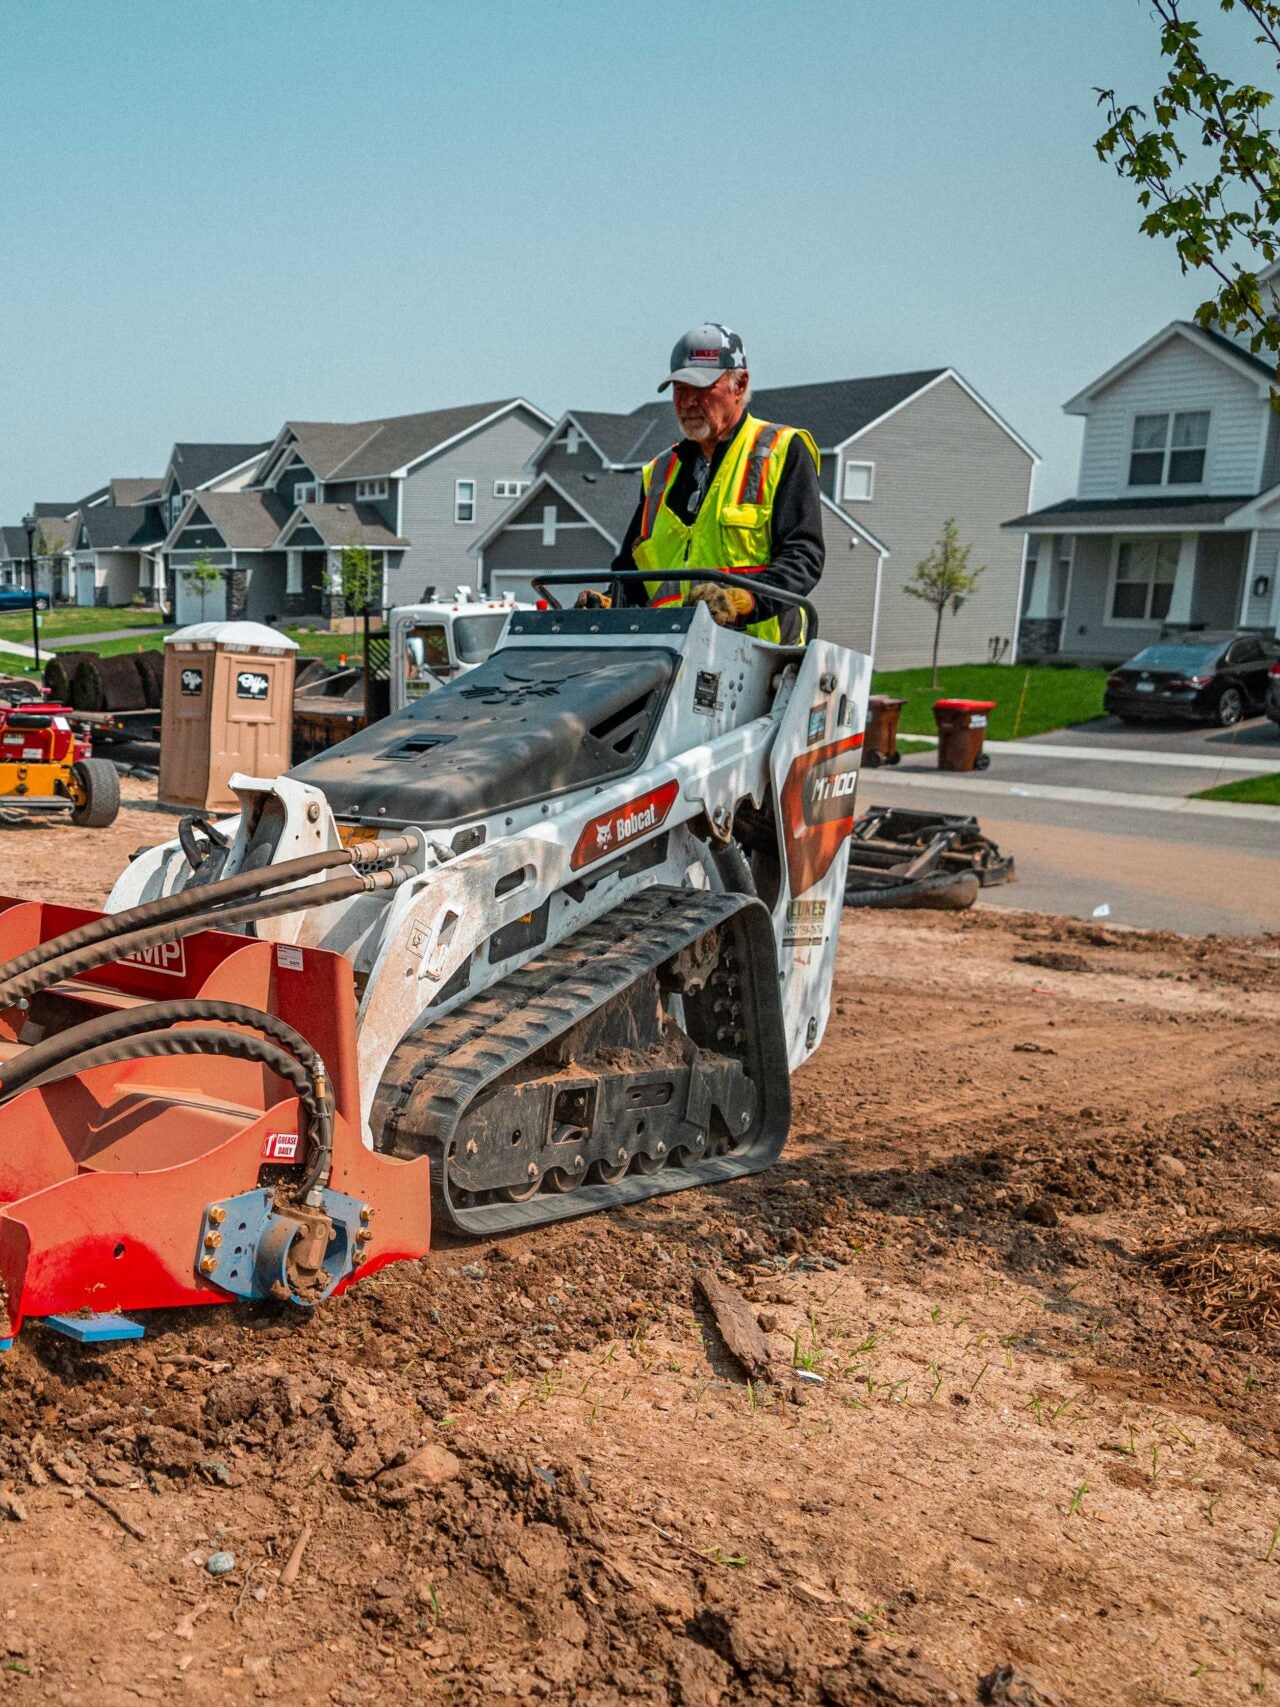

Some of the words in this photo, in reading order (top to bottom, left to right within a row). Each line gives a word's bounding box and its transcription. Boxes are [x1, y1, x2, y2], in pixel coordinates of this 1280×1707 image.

[616, 803, 656, 842] Bobcat
[790, 899, 826, 917] LUKES
[277, 1135, 297, 1145] GREASE
[277, 1146, 294, 1156] DAILY
